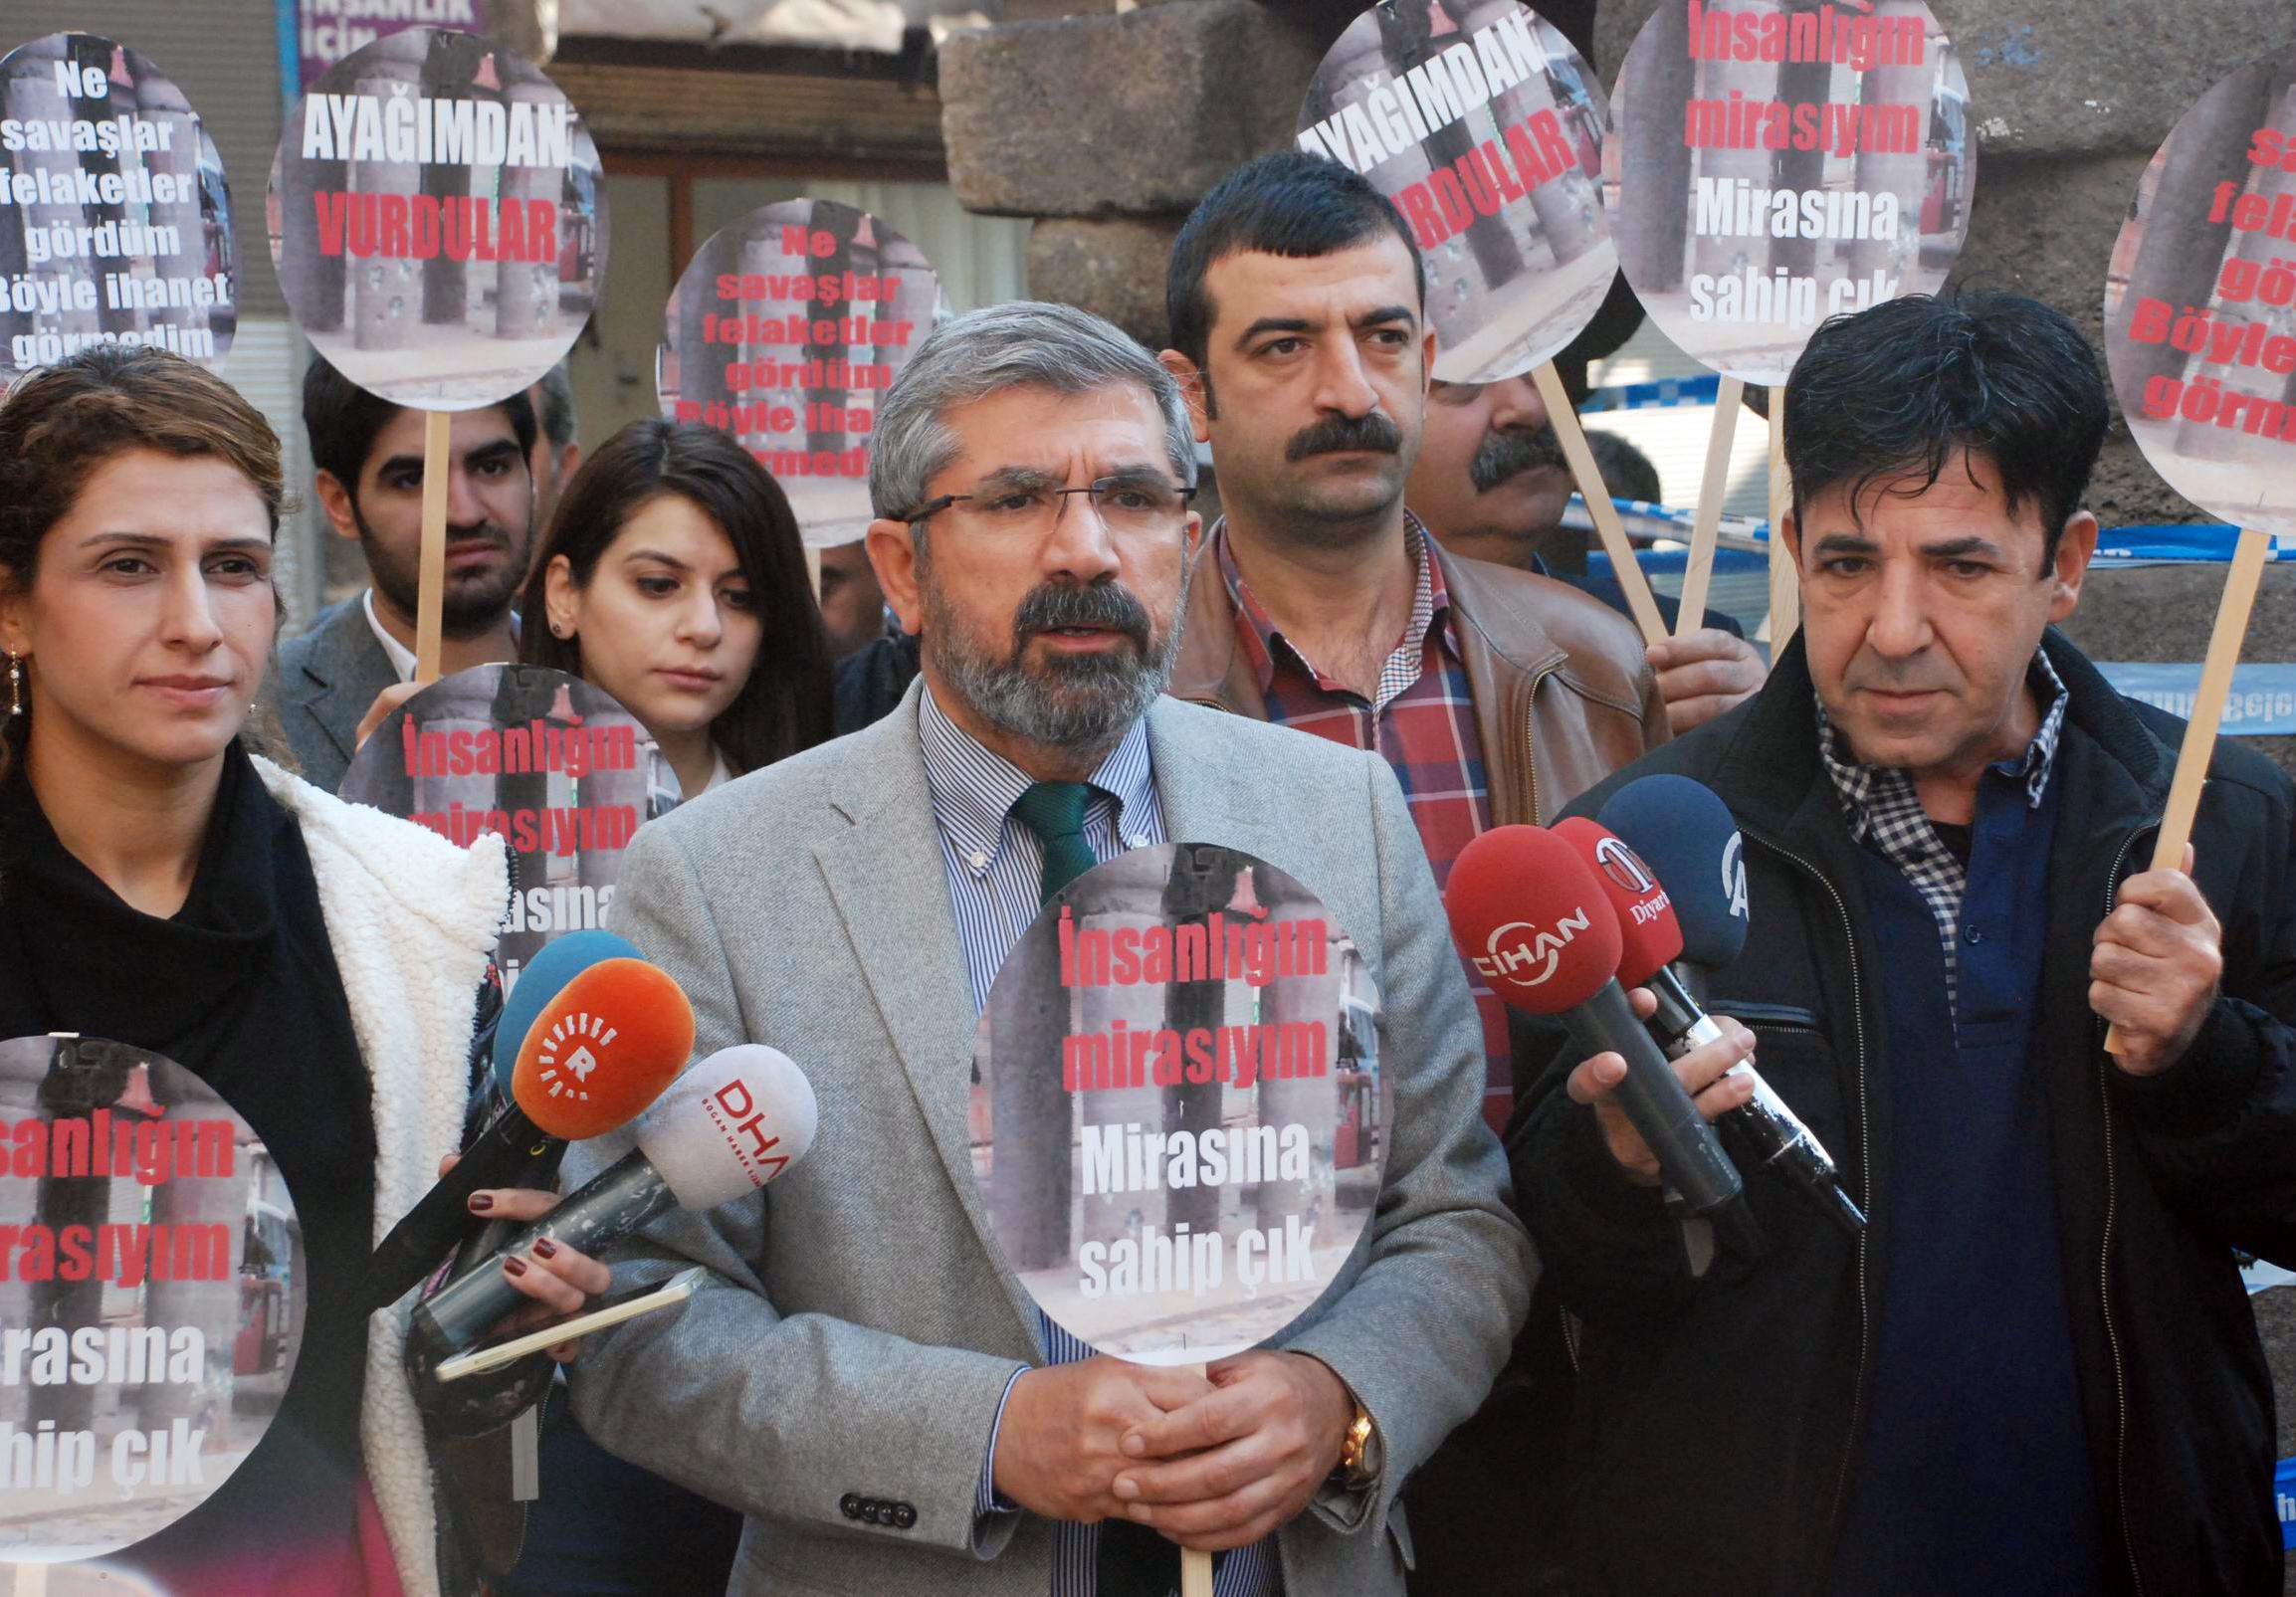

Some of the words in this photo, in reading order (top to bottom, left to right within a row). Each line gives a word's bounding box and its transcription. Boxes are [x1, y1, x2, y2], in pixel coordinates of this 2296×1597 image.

[54, 60, 108, 100] Ne
[0, 114, 173, 159] savaşlar
[303, 84, 567, 168] AYAĞIMDAN
[1685, 90, 1922, 158] mirasıyım
[0, 167, 193, 205] felaketler
[1696, 177, 1900, 241] Mirasına
[2207, 181, 2296, 244] fel
[25, 220, 181, 264] gördüm
[314, 191, 556, 264] VURDULAR
[781, 225, 837, 258] Ne
[105, 273, 230, 309] ihanet
[716, 272, 903, 307] savaşlar
[1690, 266, 1817, 331] sahip
[2217, 256, 2296, 308] gö
[702, 312, 915, 346] felaketler
[725, 358, 893, 392] gördüm
[805, 401, 874, 434] iha
[402, 712, 636, 778] İnsanlığın
[1057, 904, 1329, 988] İnsanlığın
[1062, 1019, 1328, 1093] mirasıyım
[1081, 1122, 1312, 1195] Mirasına
[1078, 1221, 1224, 1299] sahip
[1236, 1215, 1317, 1299] çık
[111, 1418, 205, 1500] çık
